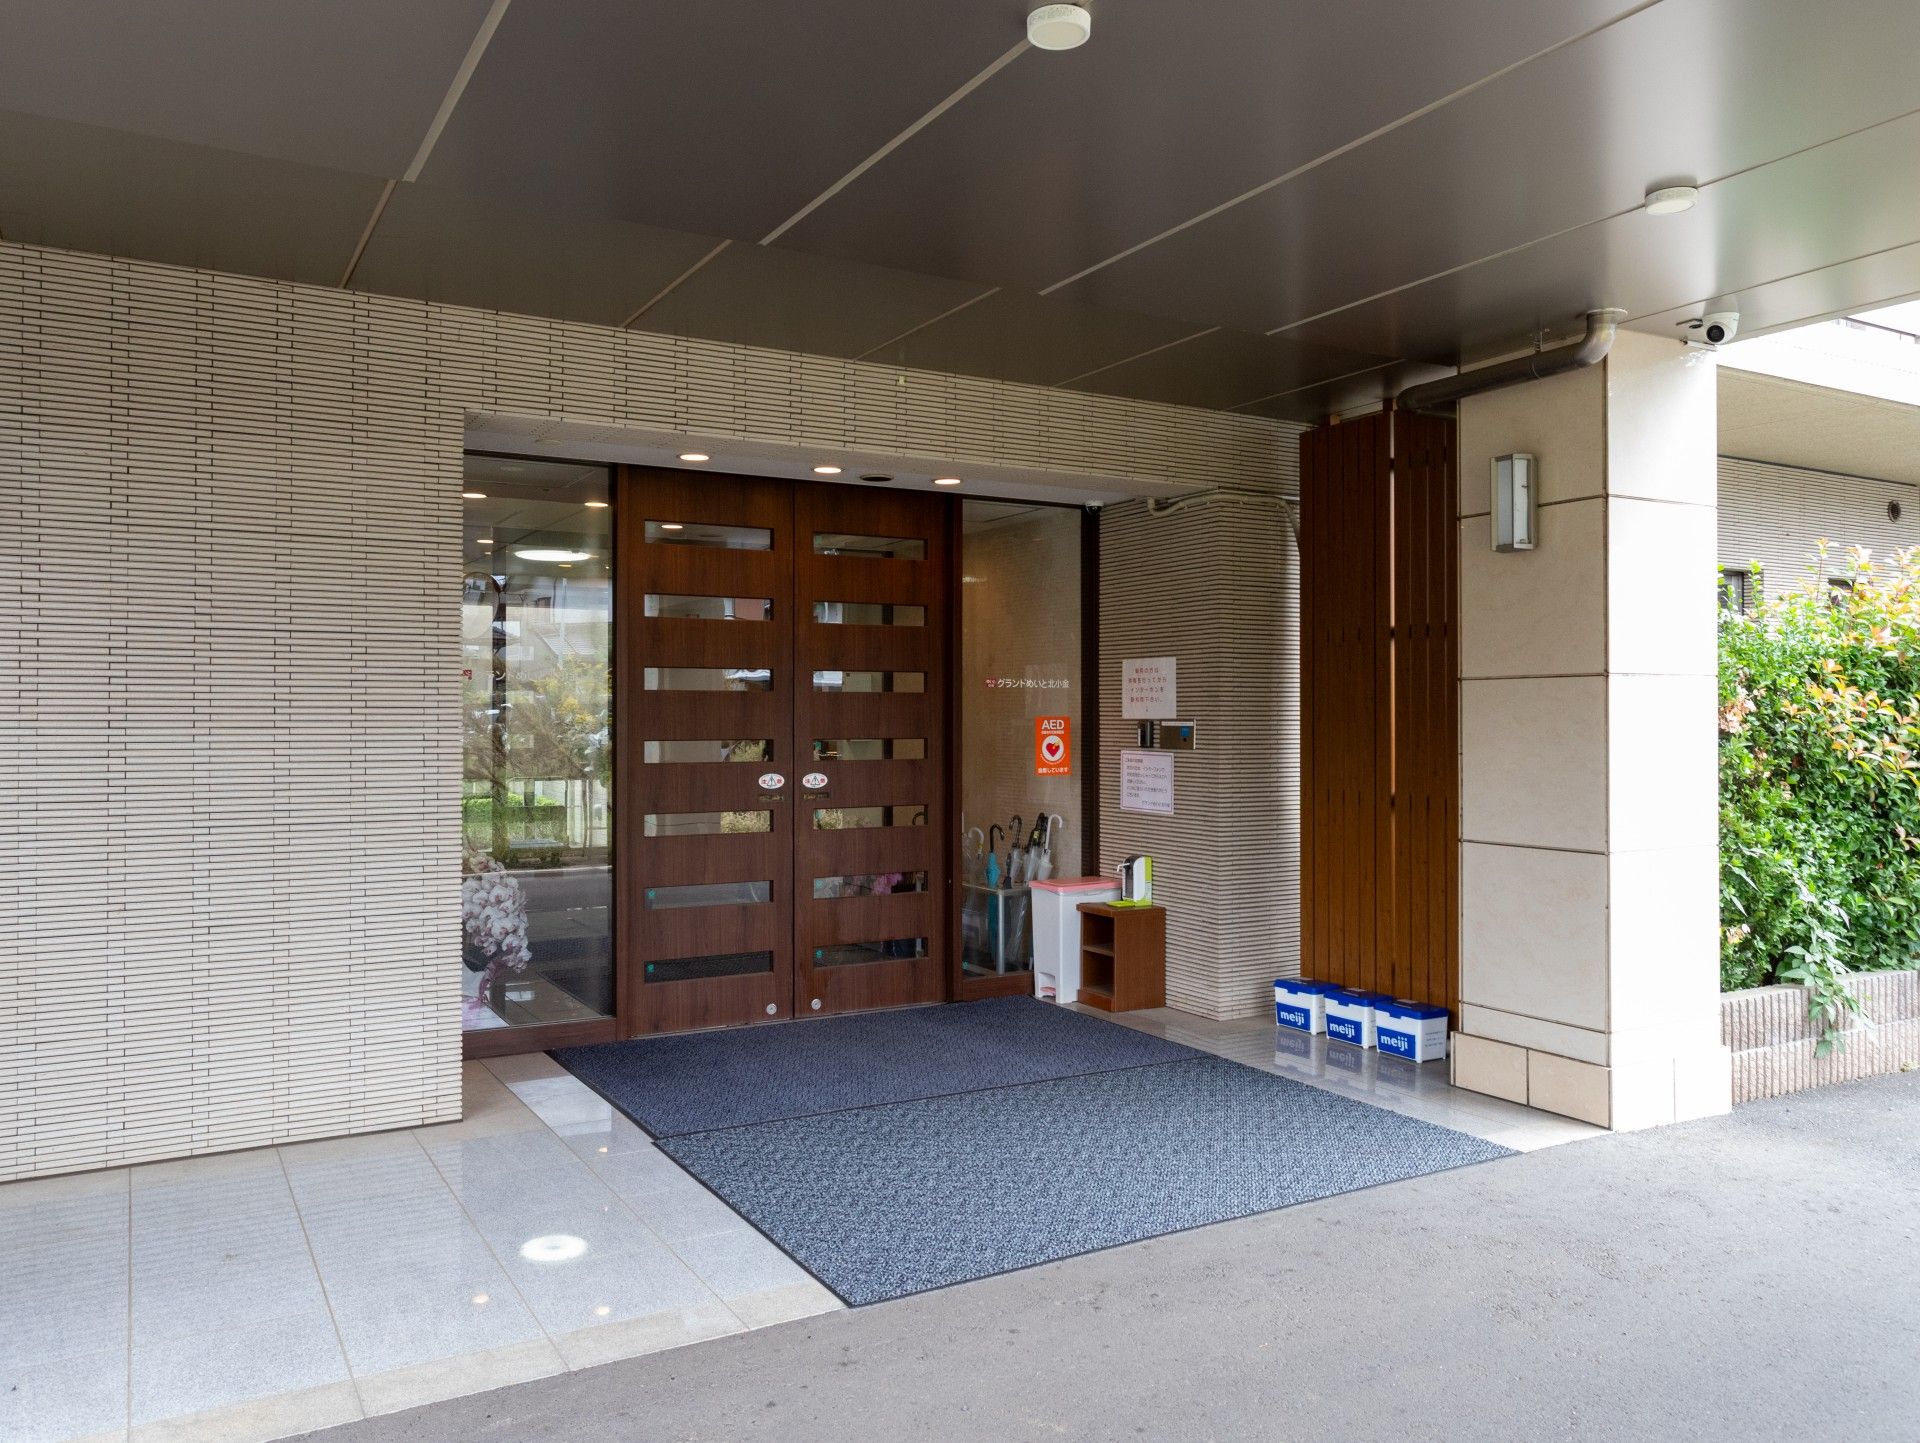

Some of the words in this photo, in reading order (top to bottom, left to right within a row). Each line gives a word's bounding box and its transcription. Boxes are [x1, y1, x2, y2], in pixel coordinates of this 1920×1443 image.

[997, 678, 1070, 689] グランドめいと北小金
[1041, 719, 1064, 730] AED
[1280, 1010, 1305, 1026] meiji
[1329, 1021, 1355, 1038] meiji
[1380, 1034, 1408, 1051] meiji
